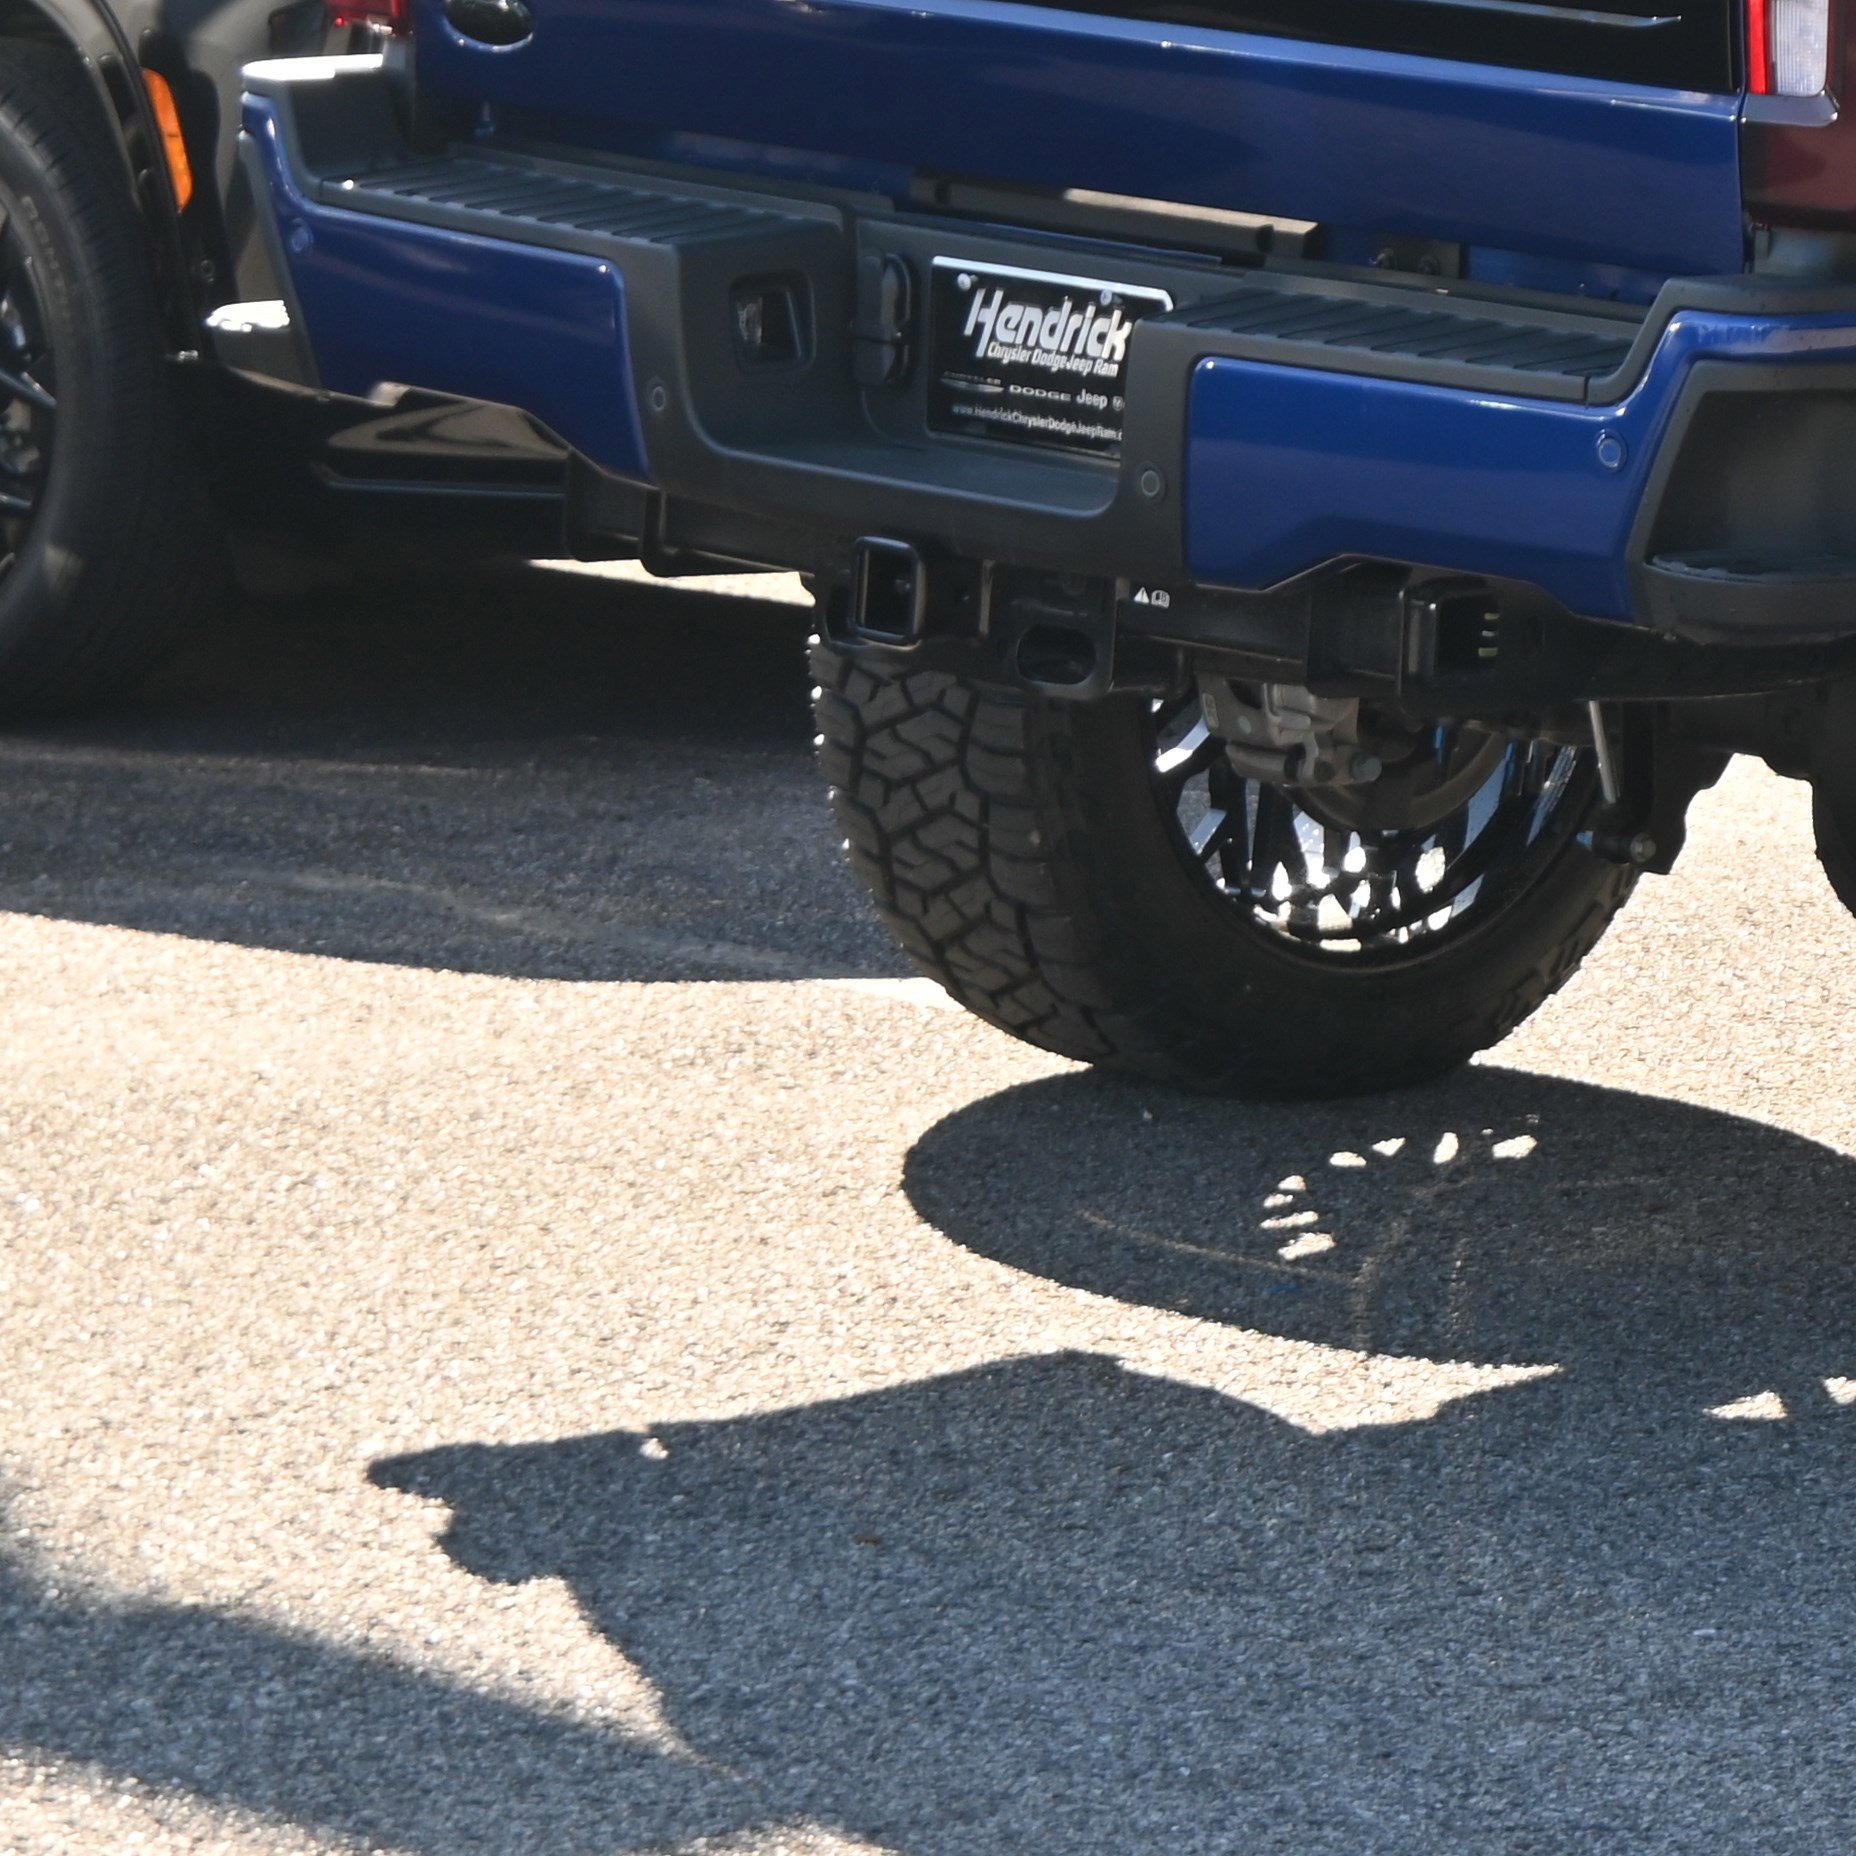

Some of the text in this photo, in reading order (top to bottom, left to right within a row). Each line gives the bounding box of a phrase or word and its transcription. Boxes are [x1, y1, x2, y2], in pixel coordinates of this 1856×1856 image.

[964, 288, 1133, 361] Hendrick
[987, 341, 1119, 378] Chrysler Dodge Jeep Ram
[1009, 384, 1072, 402] DODGE
[1076, 388, 1108, 411] Jeep
